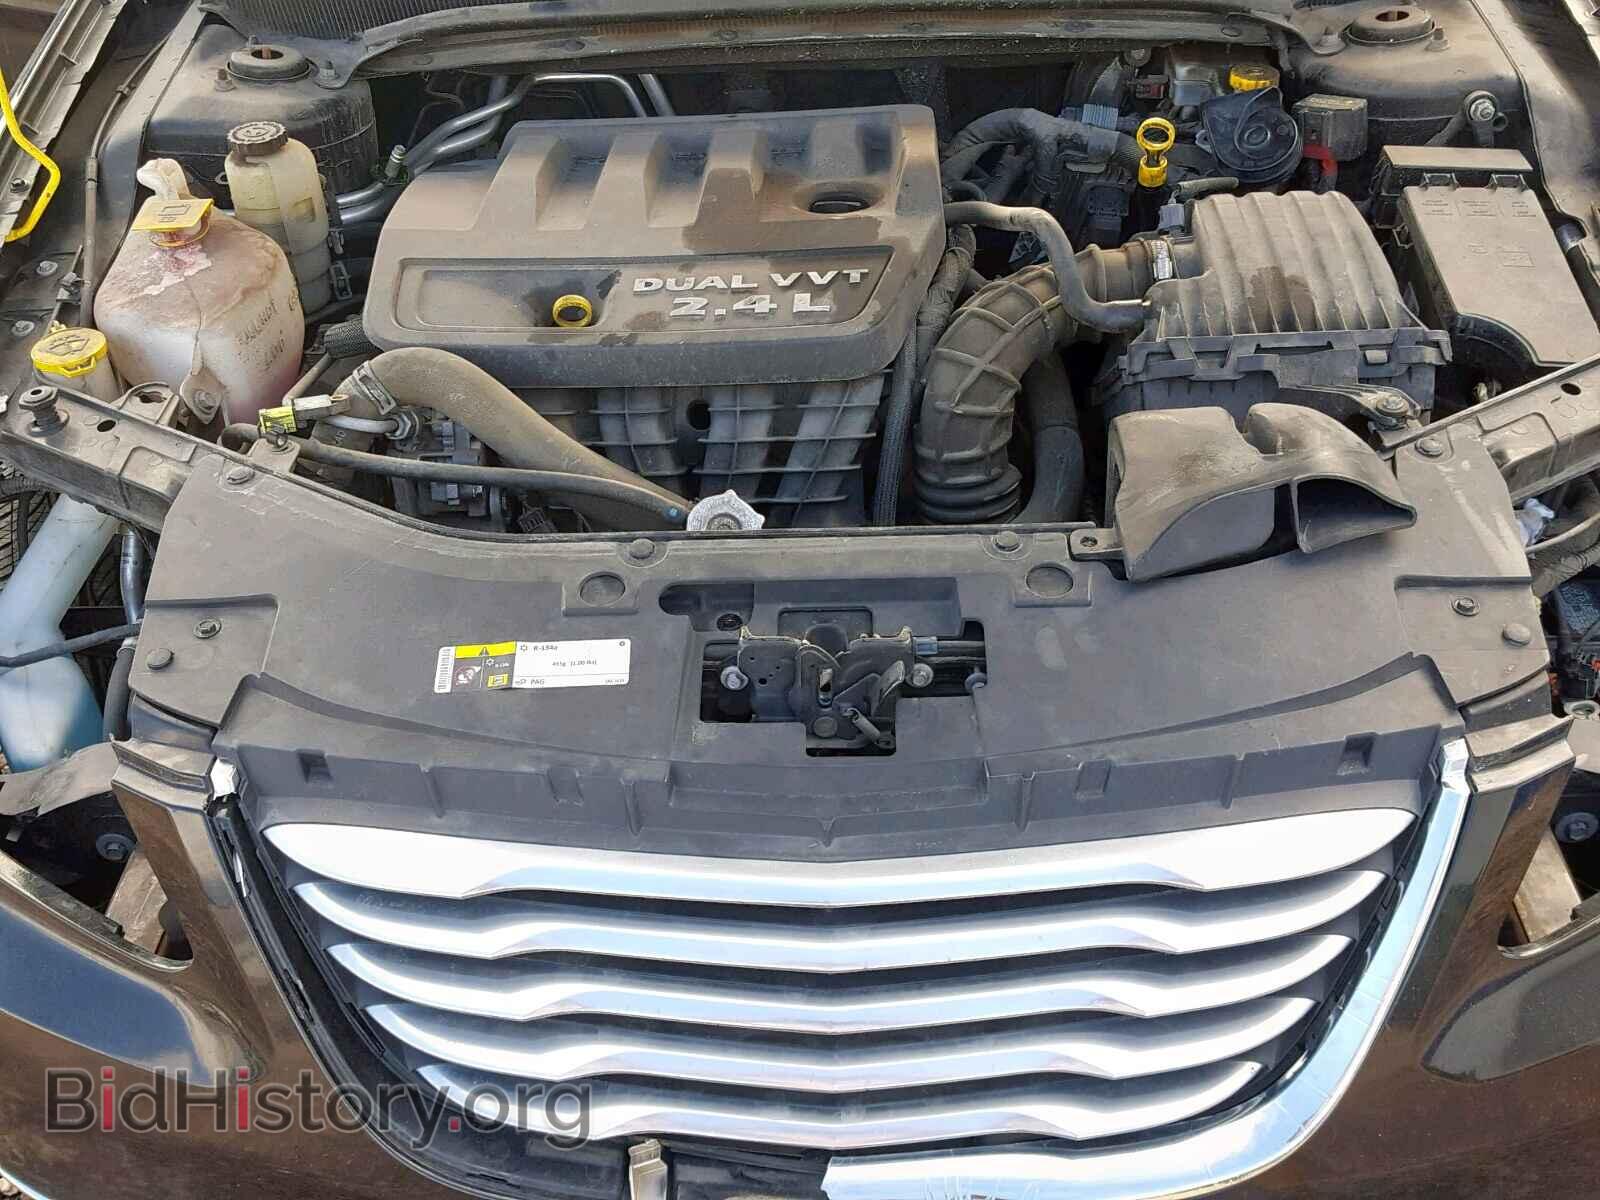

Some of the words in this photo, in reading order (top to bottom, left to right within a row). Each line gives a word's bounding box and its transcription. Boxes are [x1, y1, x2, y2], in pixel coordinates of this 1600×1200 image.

[633, 274, 758, 292] DUAL
[769, 269, 869, 287] VVT
[670, 294, 778, 318] 2.4
[792, 293, 831, 313] L
[530, 678, 545, 686] PAG
